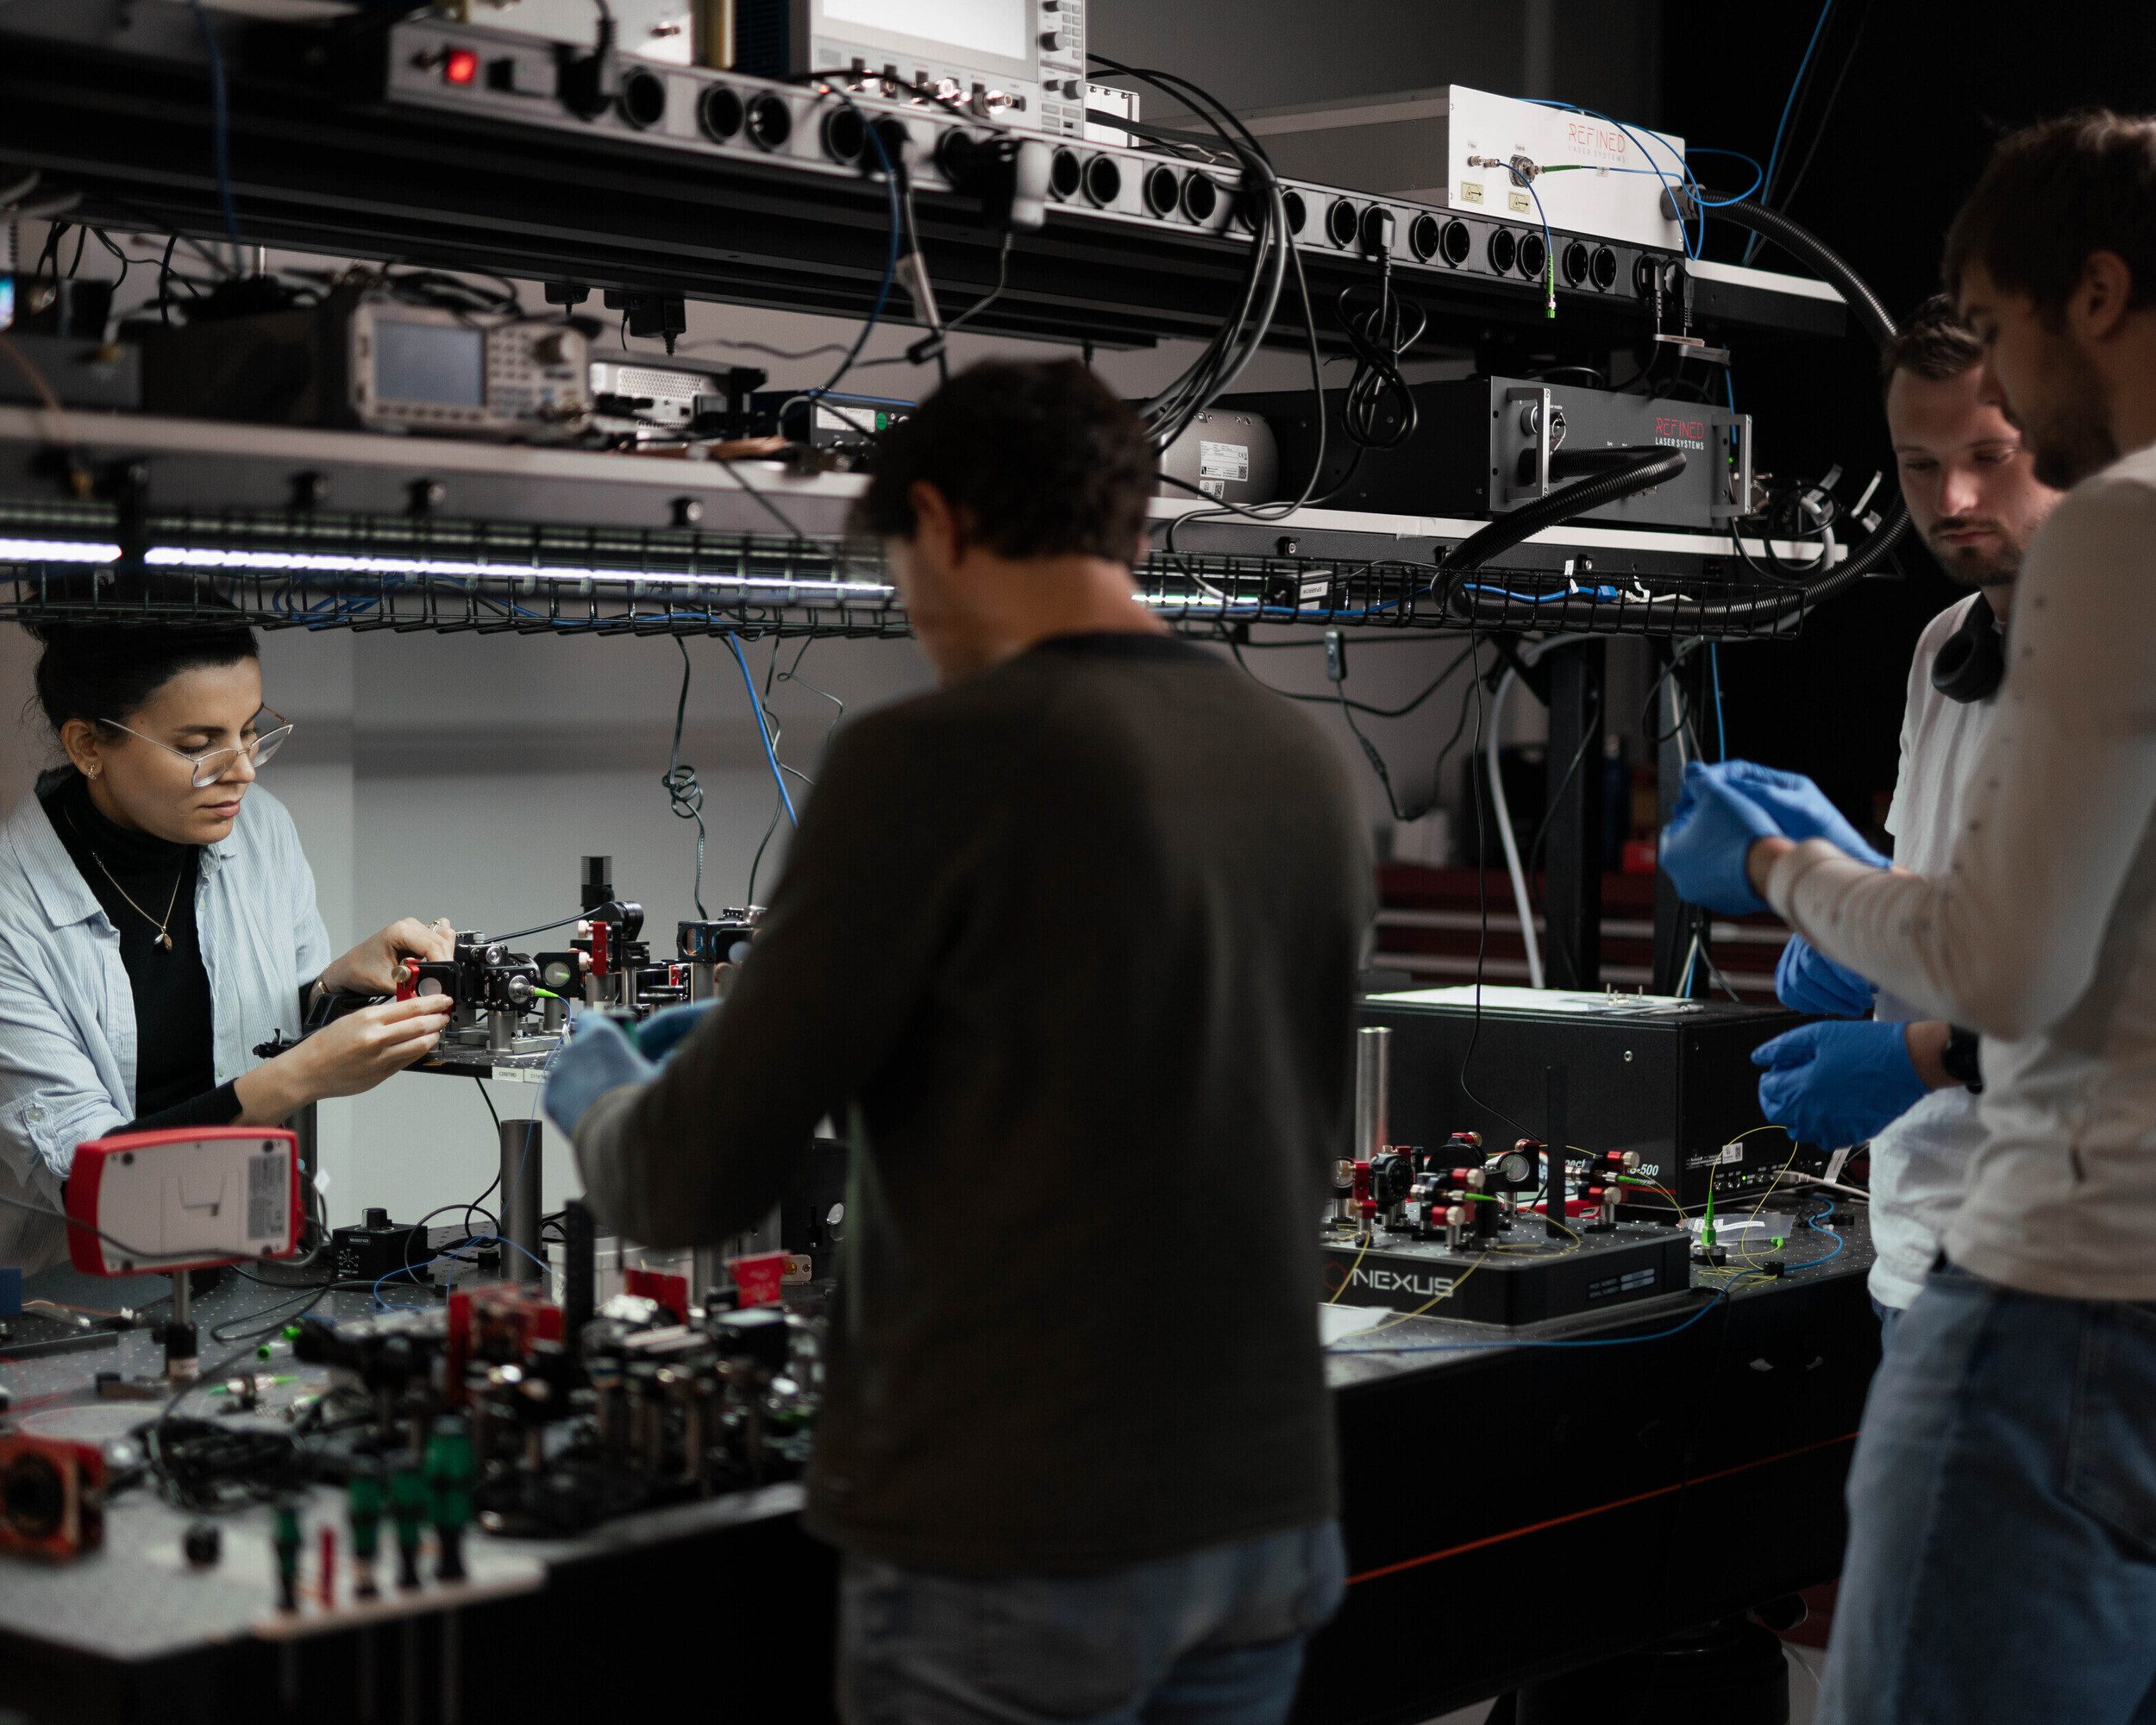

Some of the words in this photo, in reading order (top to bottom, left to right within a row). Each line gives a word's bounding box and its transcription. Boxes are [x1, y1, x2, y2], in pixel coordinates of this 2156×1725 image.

[1569, 123, 1626, 153] REFINED
[1594, 151, 1626, 164] SYSTEMS
[1656, 417, 1705, 440] REFINED
[1655, 437, 1676, 447] LASER
[1676, 438, 1704, 450] SYSTEMS
[1352, 1268, 1453, 1297] NEXUS
